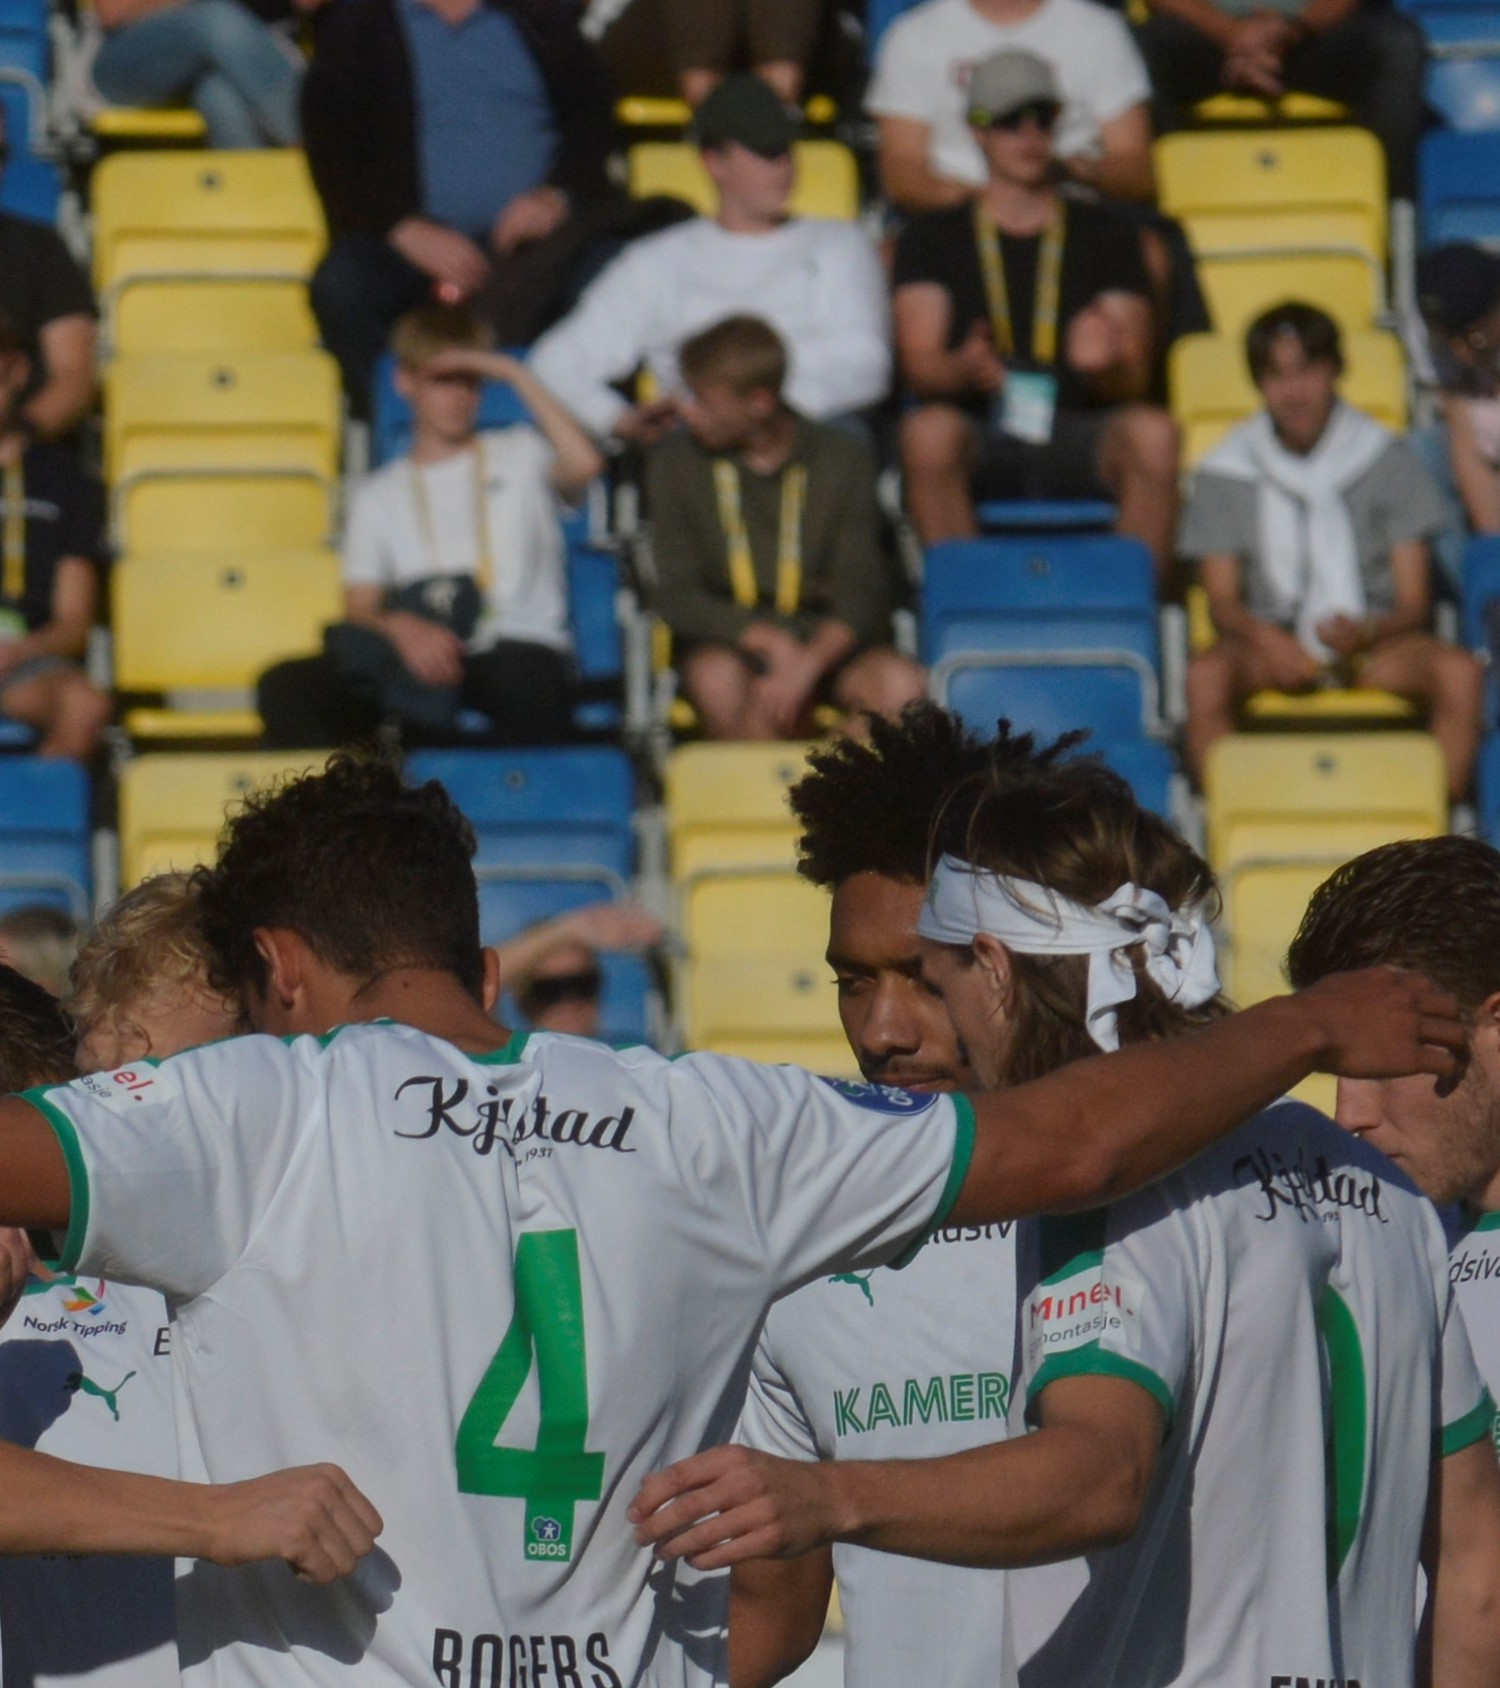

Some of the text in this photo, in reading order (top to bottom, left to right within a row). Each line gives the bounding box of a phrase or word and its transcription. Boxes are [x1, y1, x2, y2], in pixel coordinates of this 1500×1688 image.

[23, 1315, 128, 1338] Norsk Tipping
[455, 1228, 605, 1561] 4
[527, 1541, 567, 1557] OBOS
